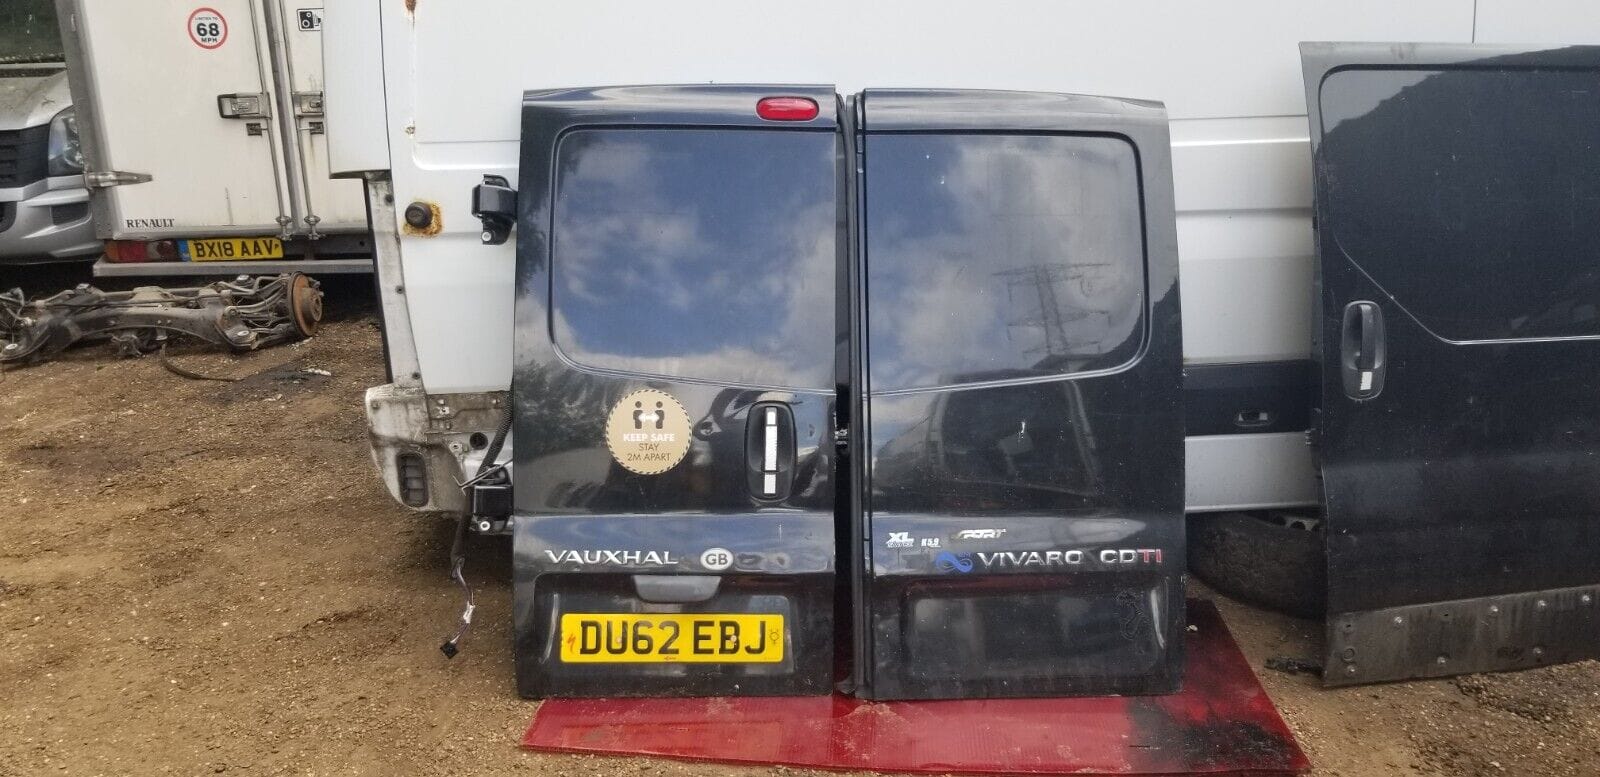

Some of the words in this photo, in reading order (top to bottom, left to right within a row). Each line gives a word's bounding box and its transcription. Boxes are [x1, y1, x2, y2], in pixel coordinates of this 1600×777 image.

[196, 22, 220, 37] 68
[126, 218, 175, 229] RENAULT
[193, 240, 235, 258] BX18
[240, 239, 273, 257] AAV
[623, 433, 649, 442] KEEP
[651, 433, 675, 442] SAFE
[638, 443, 660, 451] STAY
[627, 452, 641, 462] 2M
[643, 452, 671, 461] APART
[544, 550, 679, 565] VAUXHAL
[705, 553, 729, 566] GB
[976, 550, 1084, 568] VIVARO
[1099, 548, 1163, 565] CDTI
[579, 620, 681, 655] DU62
[693, 620, 767, 655] EBJ
